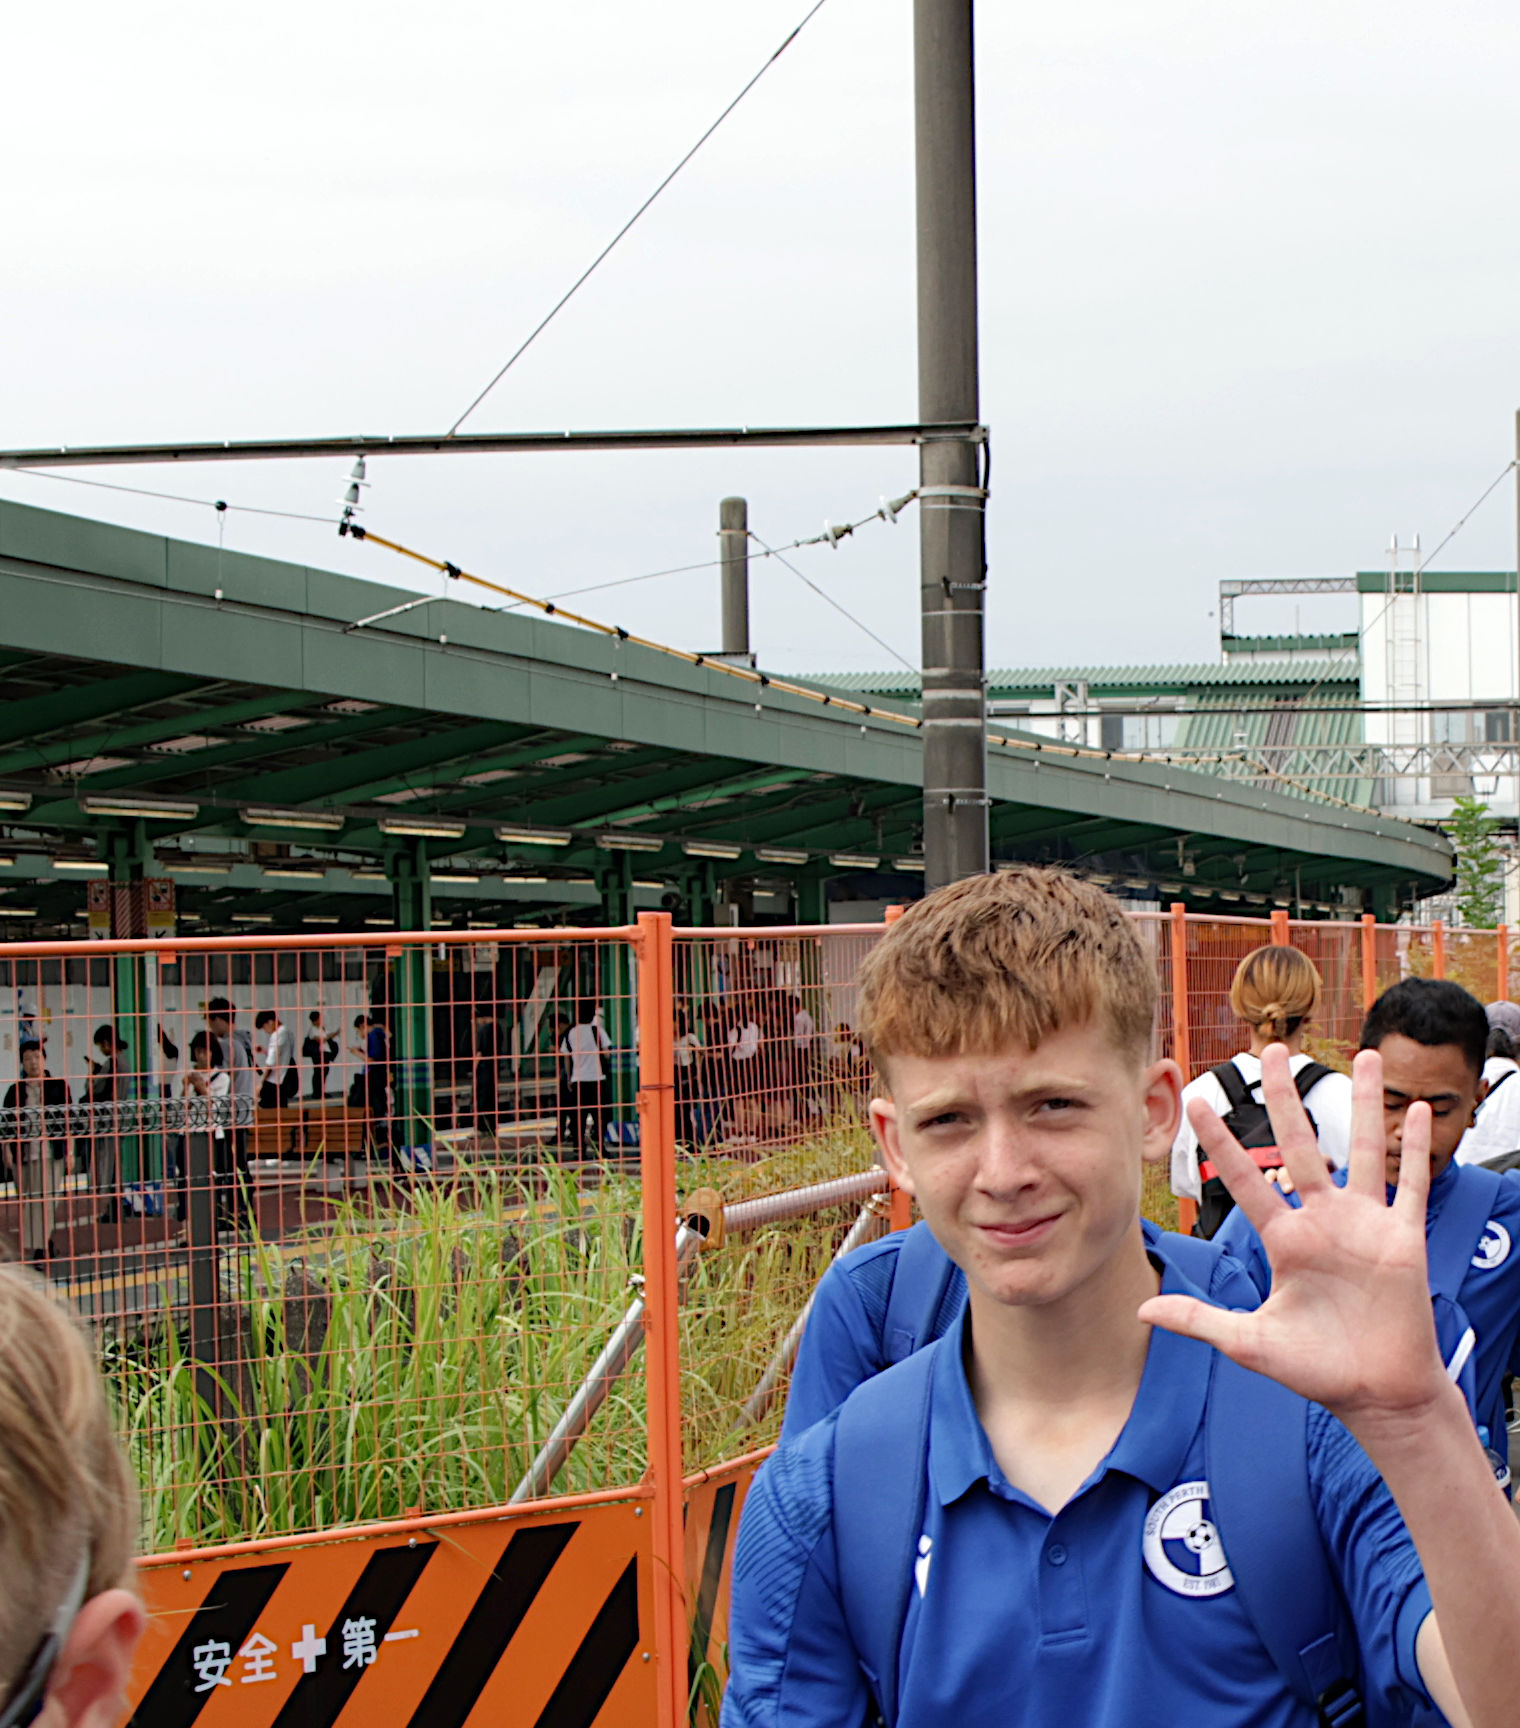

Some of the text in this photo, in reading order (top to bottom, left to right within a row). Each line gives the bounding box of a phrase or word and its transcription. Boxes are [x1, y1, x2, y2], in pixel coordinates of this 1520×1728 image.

[1146, 1486, 1205, 1536] SOUTH PERTH
[193, 1616, 420, 1693] 安全 第一
